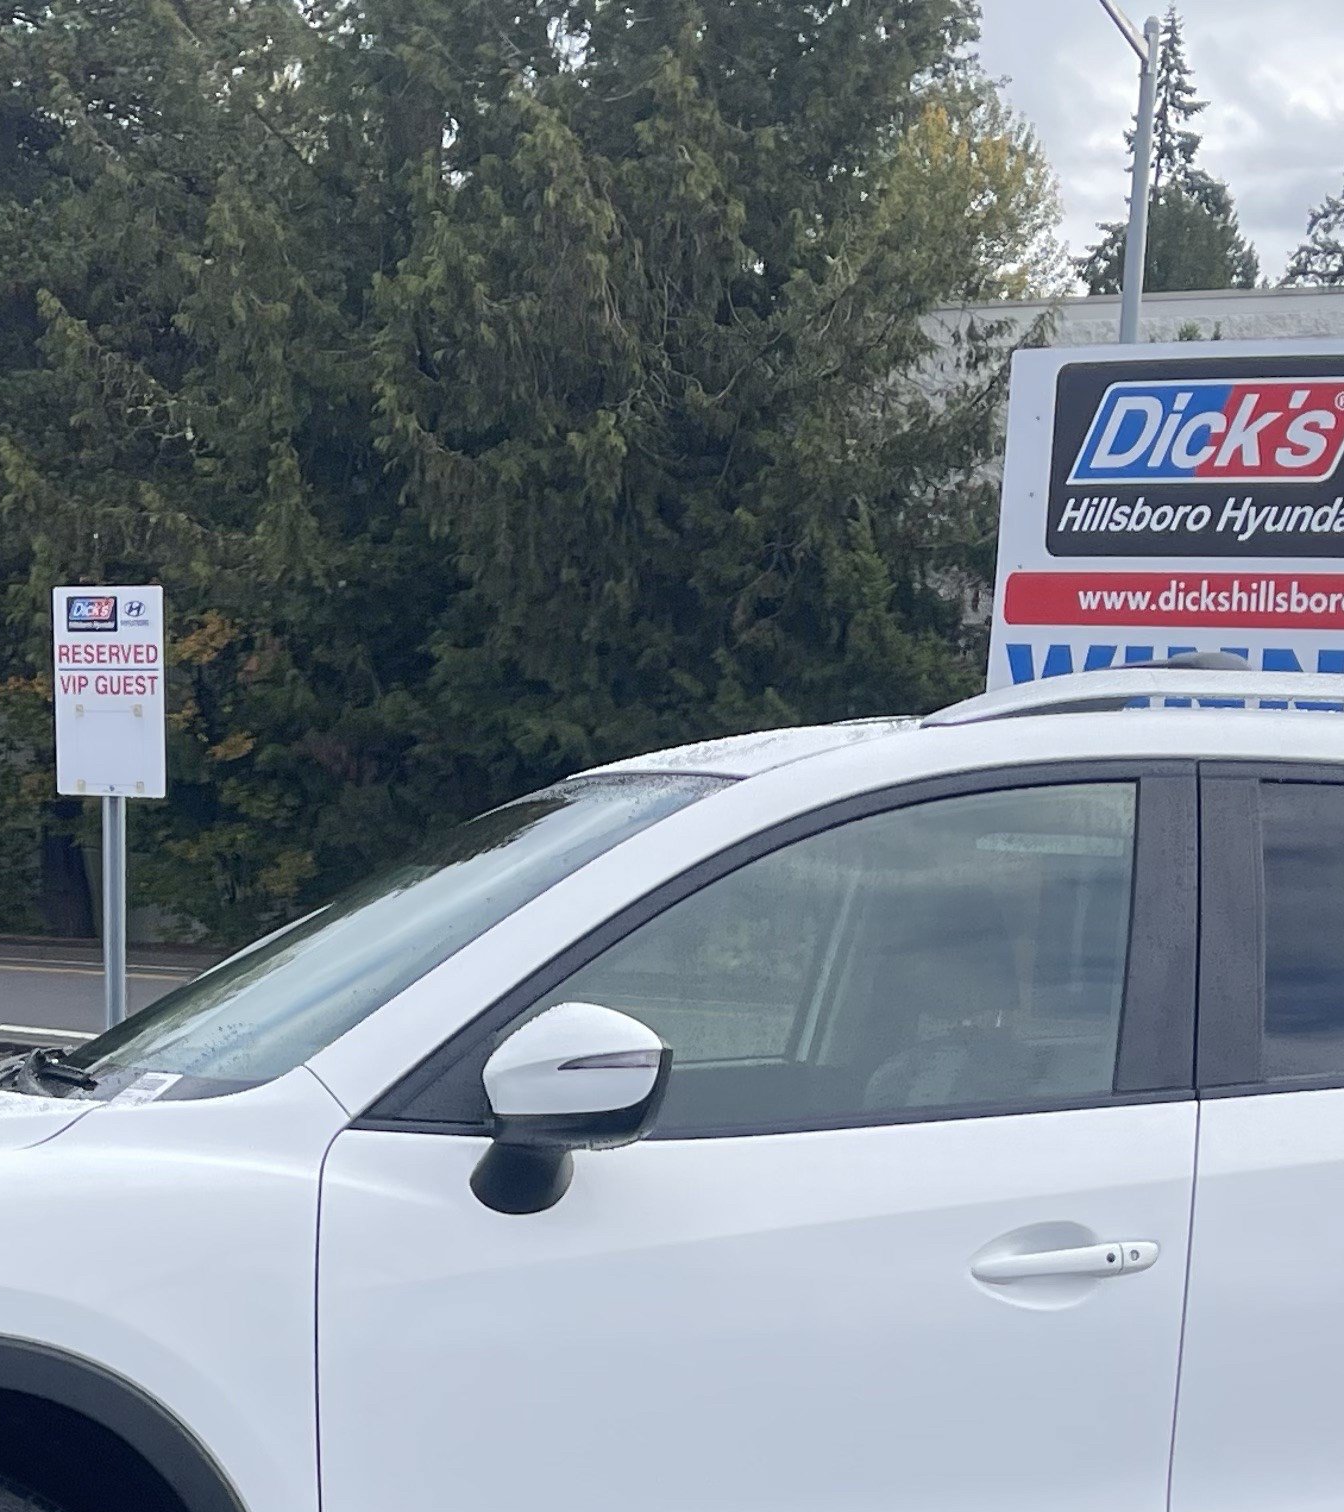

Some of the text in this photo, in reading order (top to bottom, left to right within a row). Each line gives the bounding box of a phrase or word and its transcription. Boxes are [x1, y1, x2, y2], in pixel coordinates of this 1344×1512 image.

[1089, 390, 1336, 469] Dick's
[1057, 496, 1211, 532] Hillsboro
[58, 643, 159, 664] RESERVED
[60, 675, 159, 696] VIP GUEST
